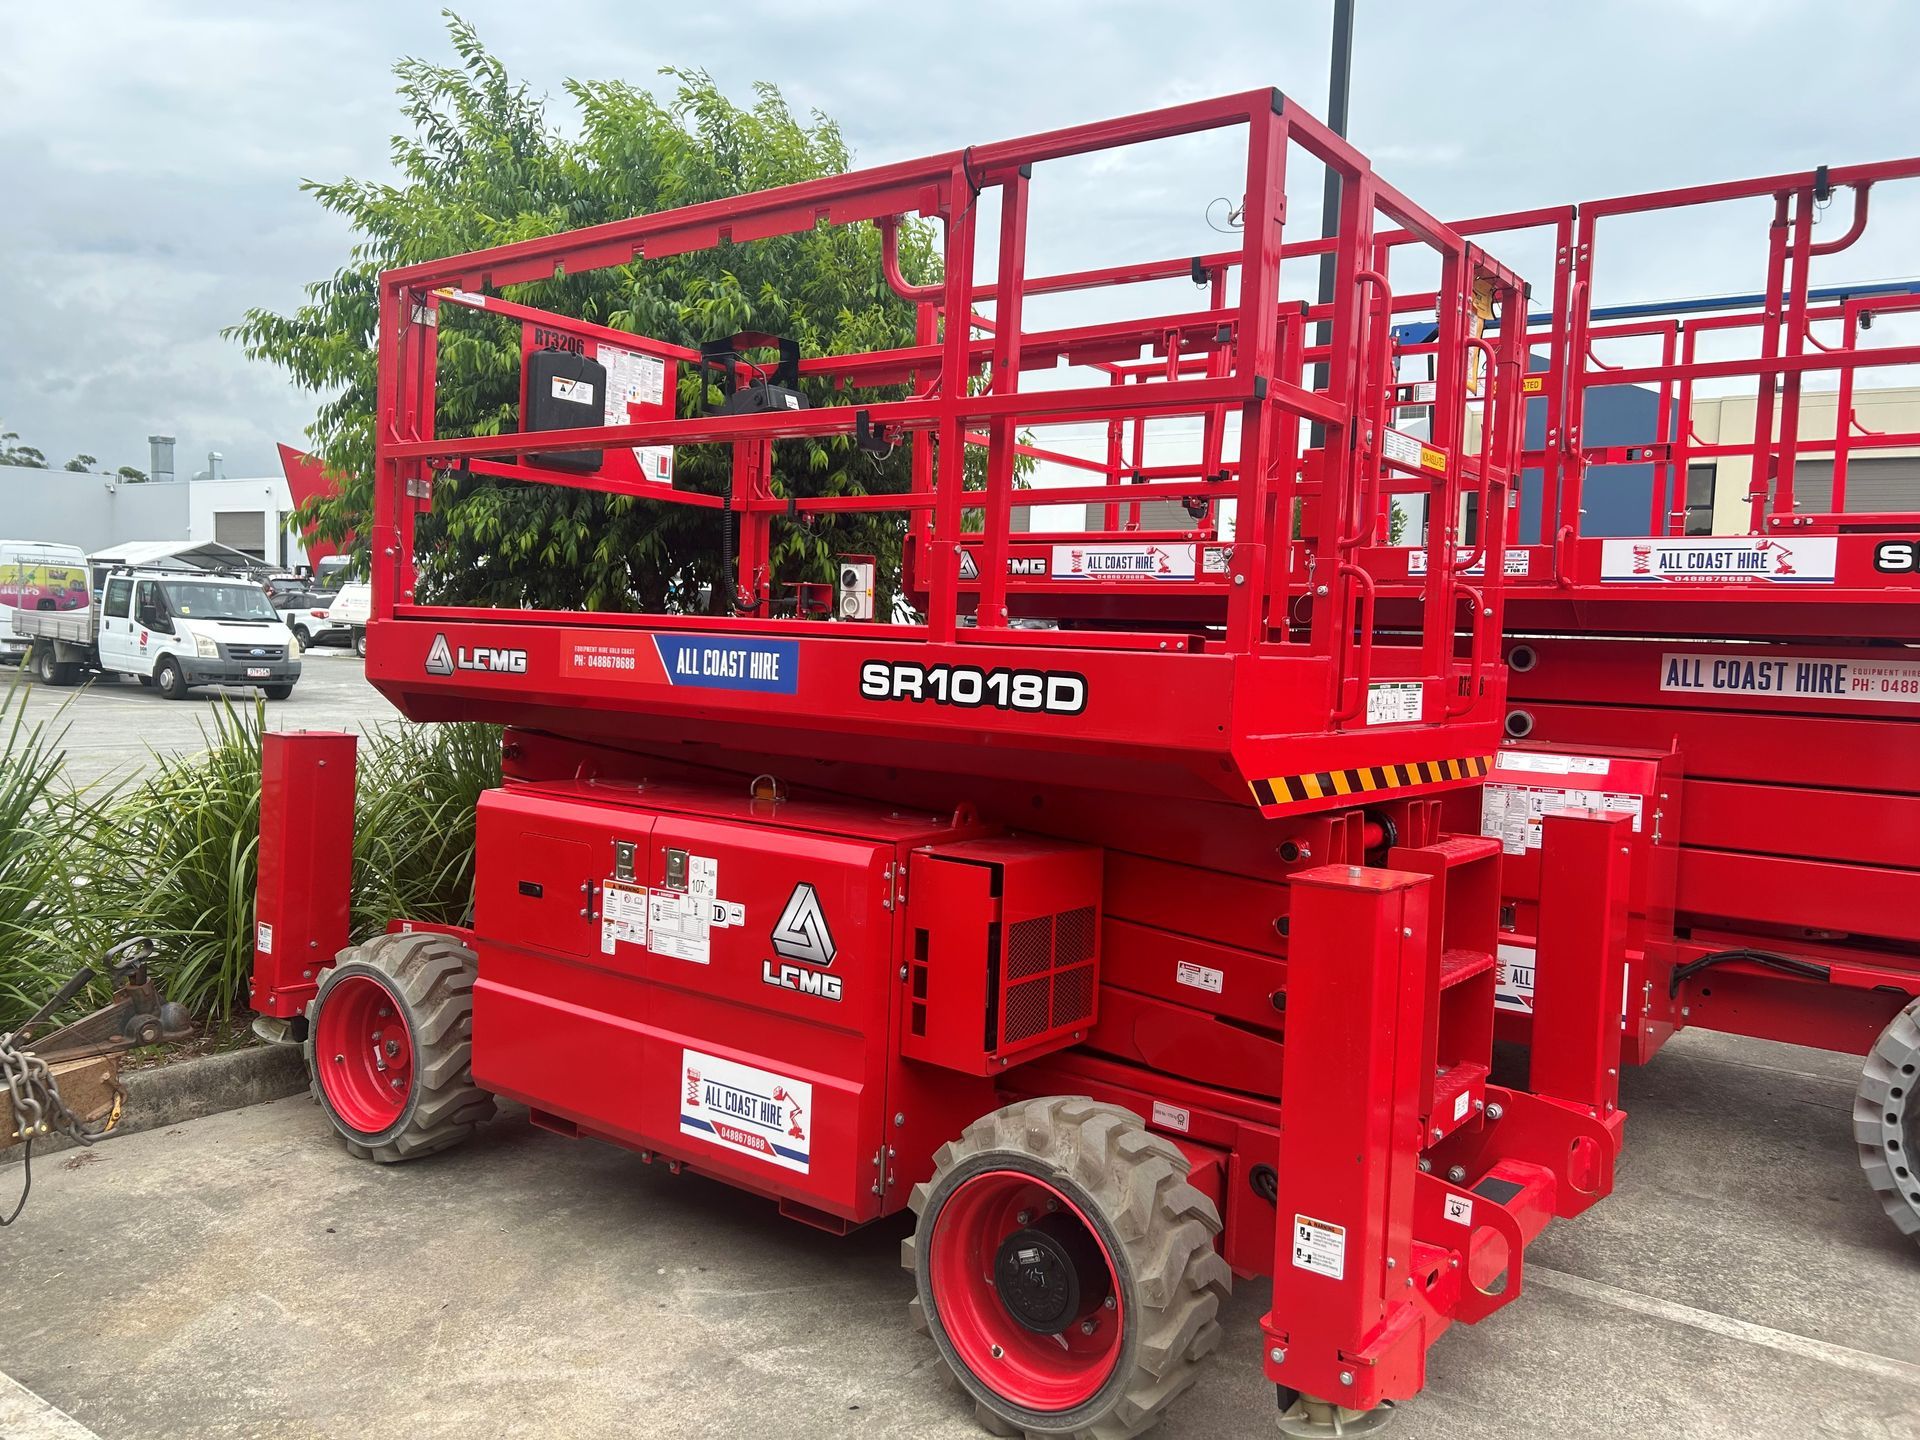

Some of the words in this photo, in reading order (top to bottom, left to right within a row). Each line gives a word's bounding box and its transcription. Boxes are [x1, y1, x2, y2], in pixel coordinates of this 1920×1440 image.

[534, 327, 585, 355] RT3206
[1087, 556, 1102, 569] ALL
[1105, 556, 1133, 569] COAST
[1135, 556, 1155, 569] HIRE
[1659, 552, 1683, 569] ALL
[1687, 552, 1731, 569] COAST
[1737, 552, 1768, 569] HIRE
[1877, 543, 1920, 570] S
[1007, 558, 1047, 575] MG
[574, 654, 586, 667] PH:
[588, 655, 635, 670] 0488678688
[676, 647, 699, 675] ALL
[703, 649, 747, 678] COAST
[749, 652, 780, 681] HIRE
[1666, 657, 1705, 688] ALL
[1713, 659, 1789, 691] COAST
[1795, 663, 1848, 694] HIRE
[1852, 668, 1899, 676] EQUIPMENT
[861, 662, 1086, 713] SR1018D
[1457, 675, 1485, 697] RT36
[1851, 678, 1875, 692] PH:
[703, 860, 708, 874] L
[618, 884, 640, 894] WARNING
[692, 880, 705, 893] 107
[712, 904, 727, 923] D
[1512, 968, 1531, 986] ALL
[705, 1084, 722, 1108] ALL
[725, 1091, 758, 1119] COAST
[760, 1100, 782, 1127] HIRE
[721, 1127, 765, 1150] 0488678688
